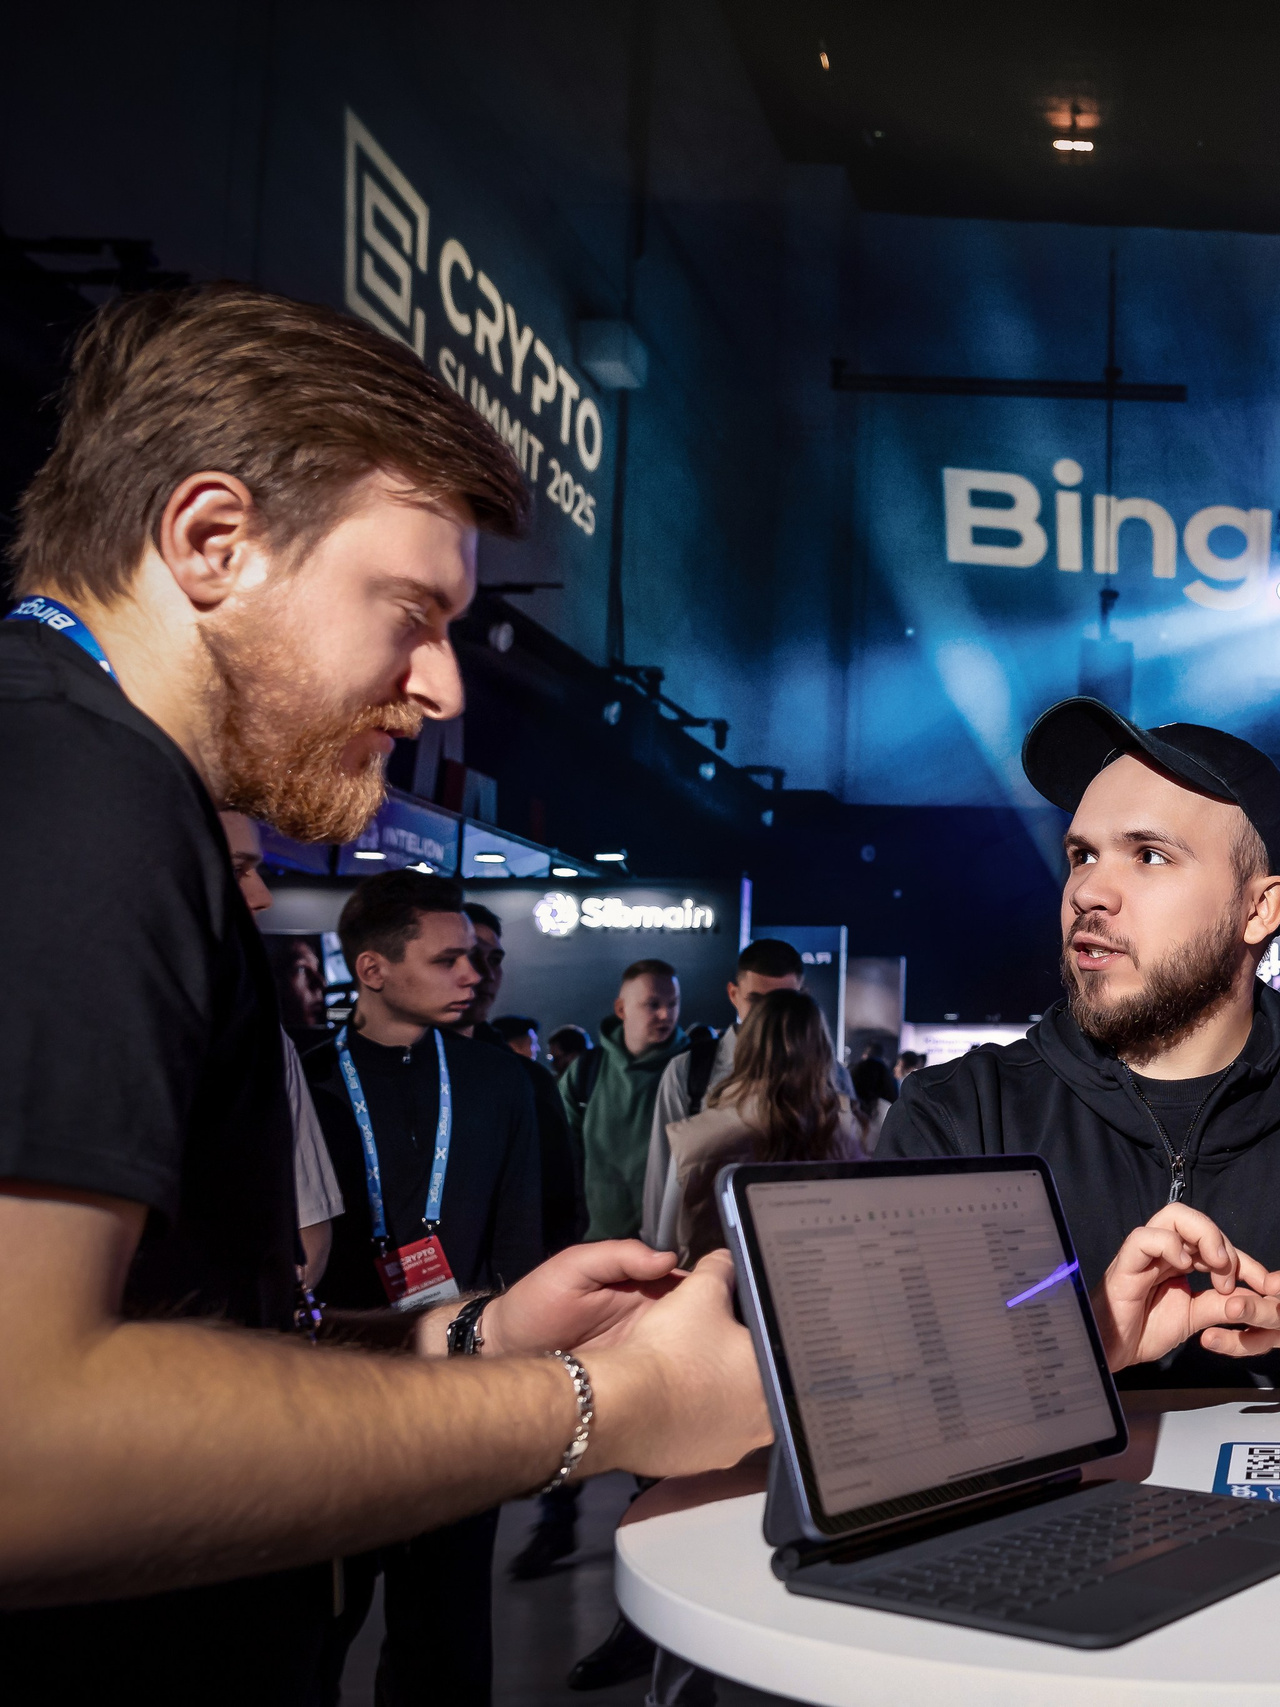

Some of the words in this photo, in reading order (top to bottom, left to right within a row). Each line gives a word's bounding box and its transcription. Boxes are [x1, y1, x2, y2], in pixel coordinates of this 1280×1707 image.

[438, 237, 602, 473] CRYPTO
[547, 458, 597, 537] 2025
[942, 458, 1273, 612] Bing
